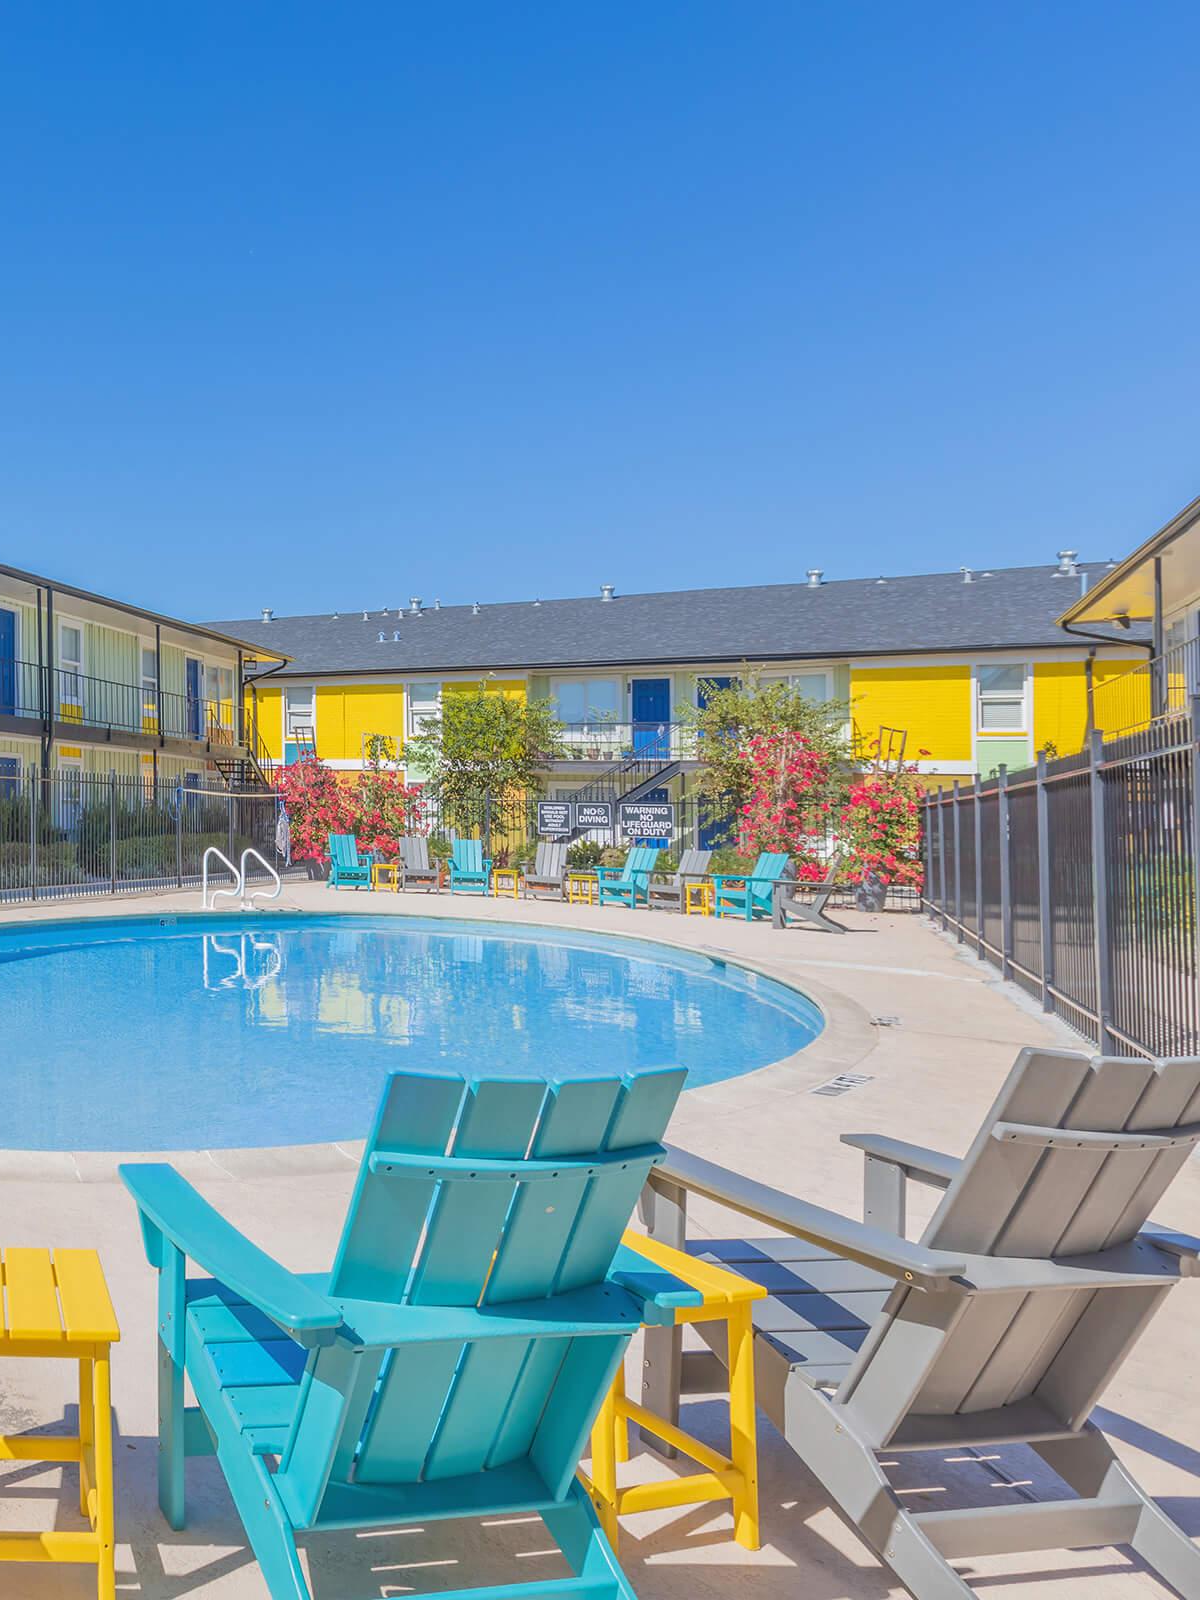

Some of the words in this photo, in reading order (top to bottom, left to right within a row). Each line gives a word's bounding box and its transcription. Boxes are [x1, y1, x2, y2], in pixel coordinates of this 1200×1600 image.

[583, 807, 597, 815] NO
[625, 806, 668, 815] WARNING
[579, 815, 608, 823] DIVING
[622, 820, 672, 829] LIFEGUARD
[643, 828, 666, 836] DUTY
